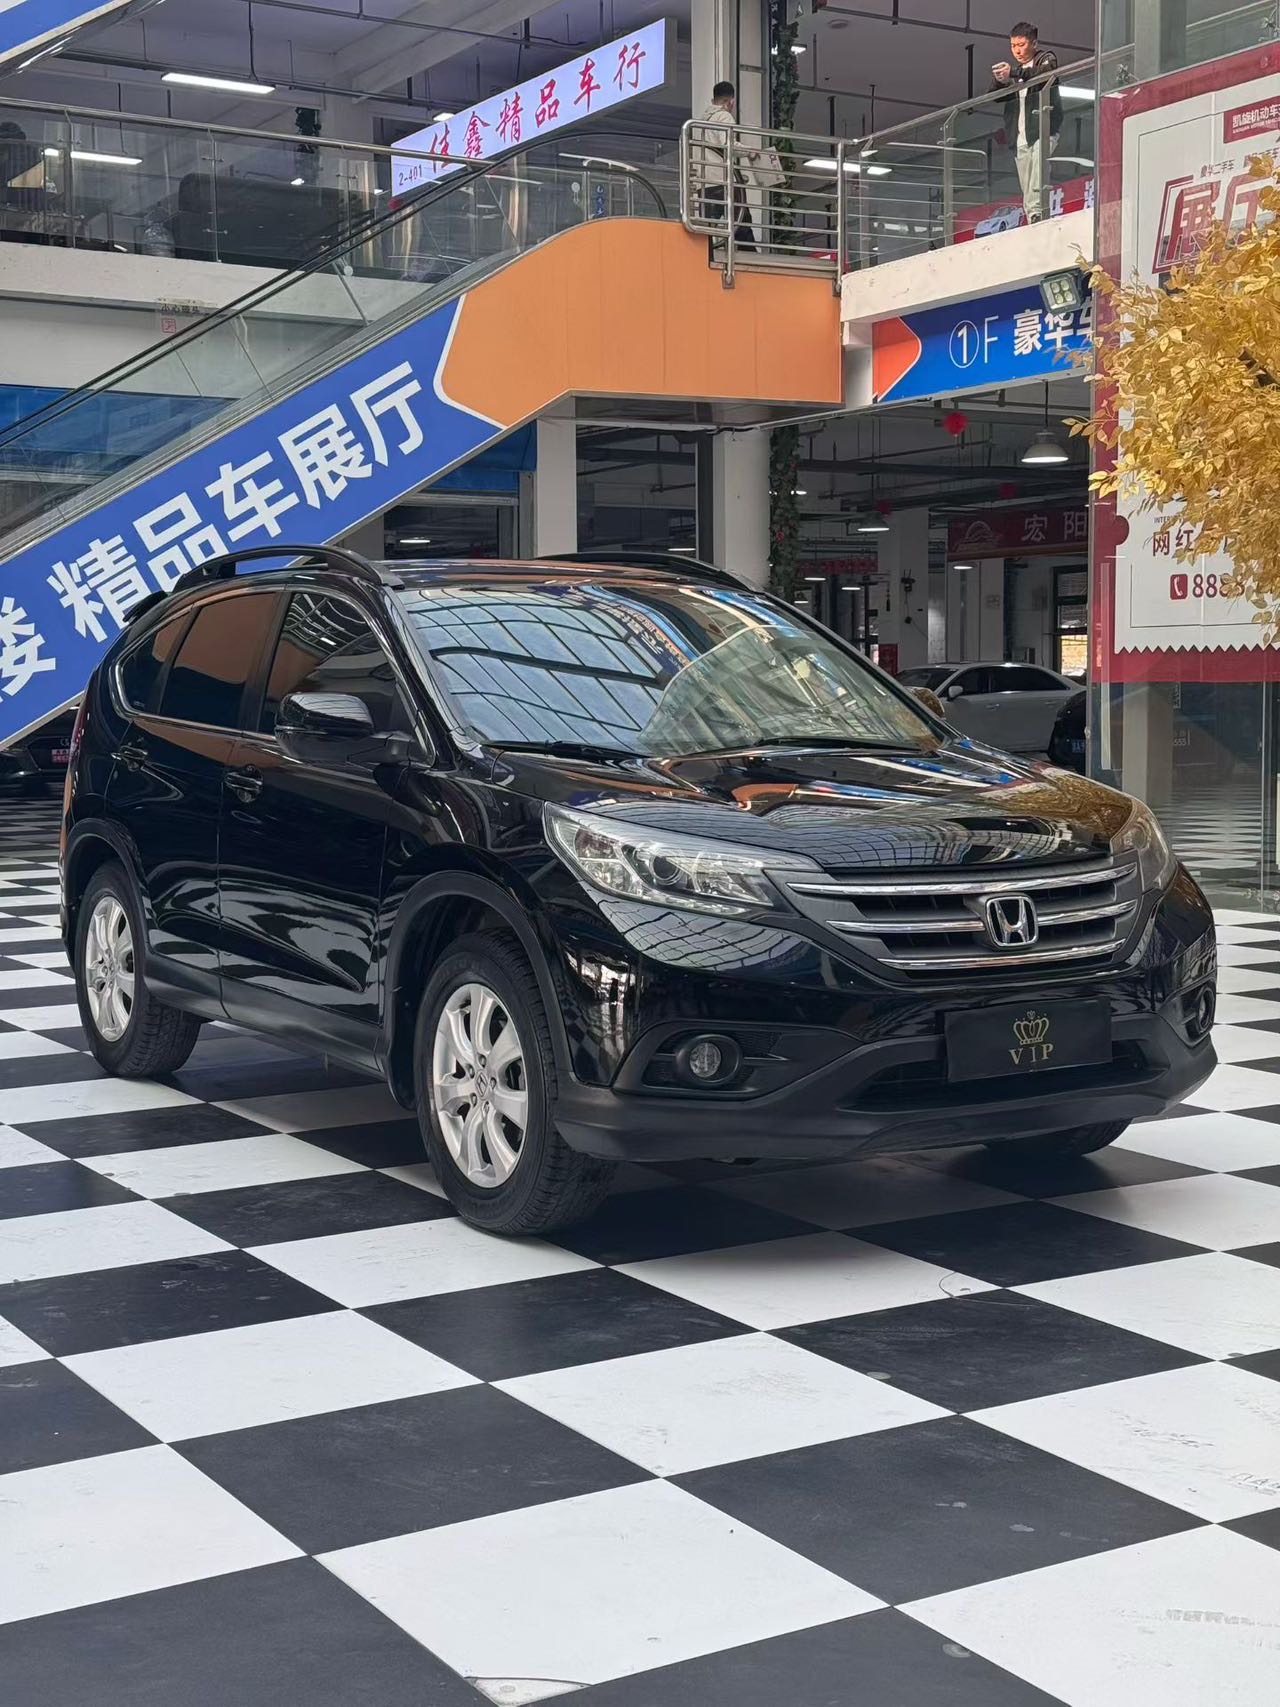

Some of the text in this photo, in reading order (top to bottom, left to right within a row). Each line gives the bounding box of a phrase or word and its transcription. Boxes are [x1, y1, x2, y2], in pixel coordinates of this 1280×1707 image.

[398, 164, 422, 186] 2-401
[46, 361, 424, 643] 精品车展厅
[1021, 511, 1088, 542] 宏阳
[1008, 1043, 1054, 1065] VIP
